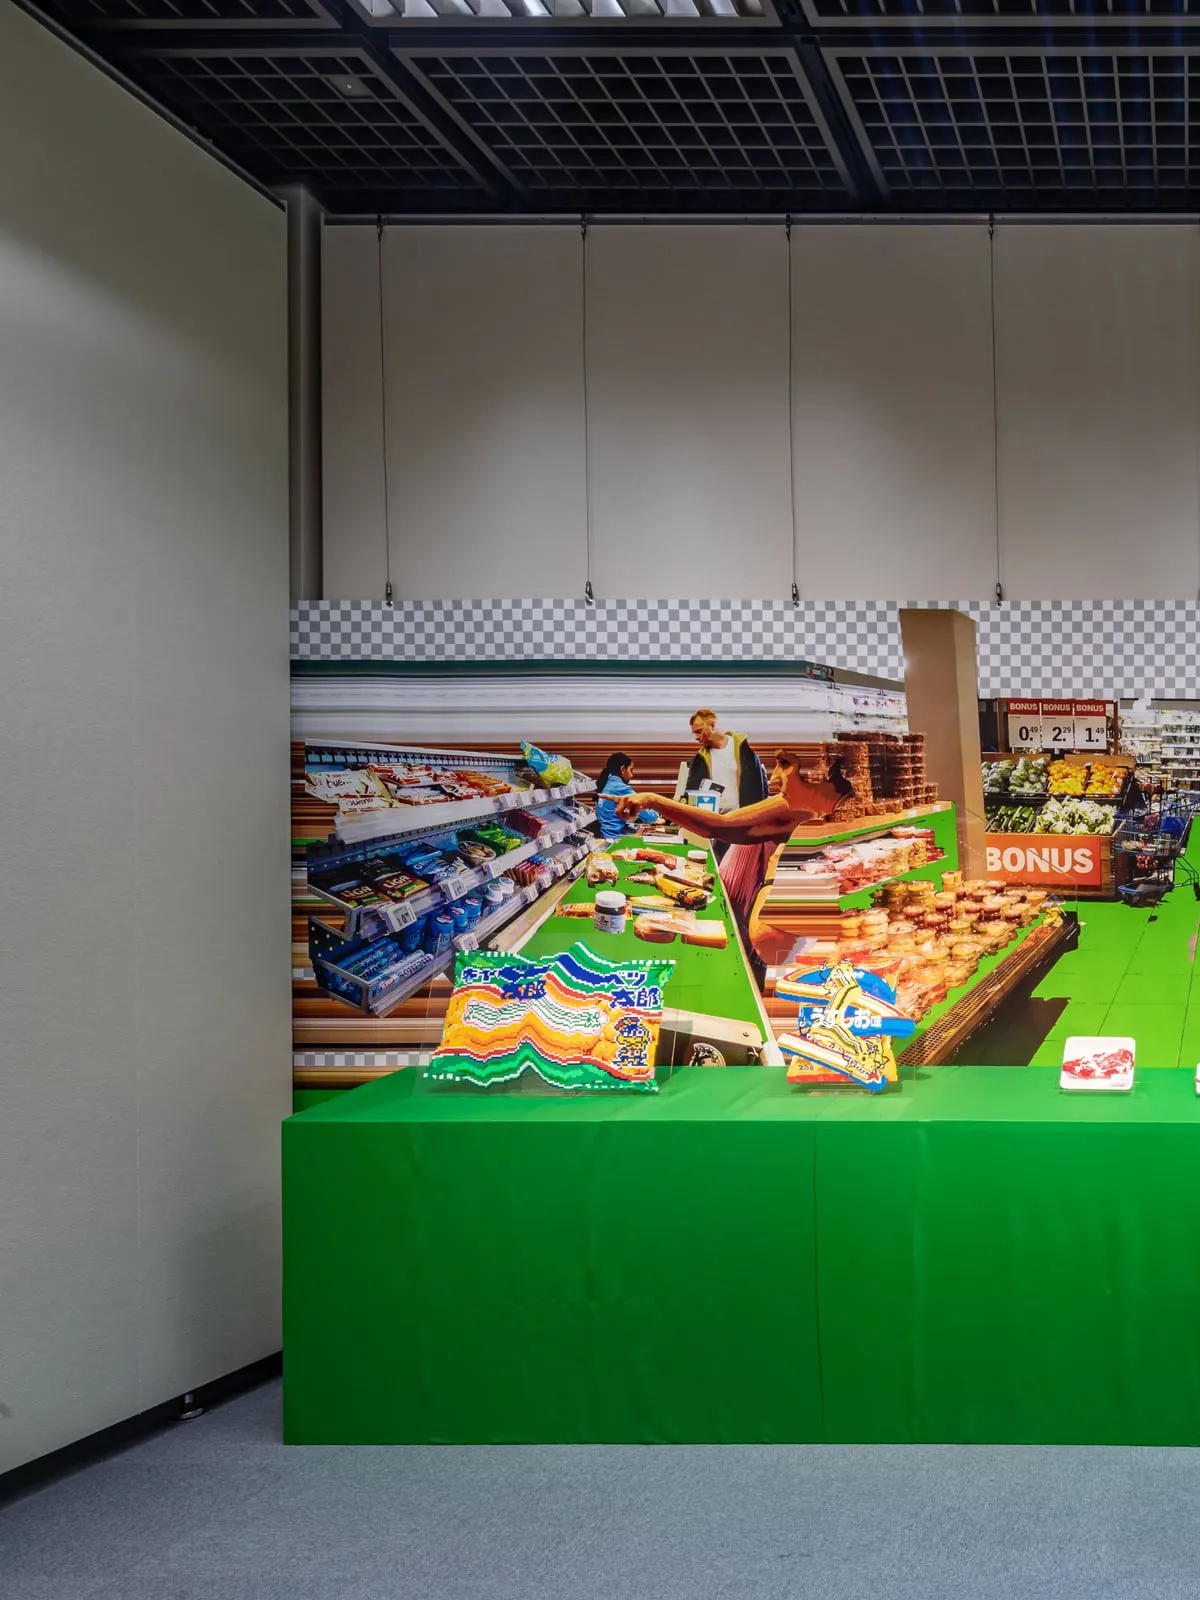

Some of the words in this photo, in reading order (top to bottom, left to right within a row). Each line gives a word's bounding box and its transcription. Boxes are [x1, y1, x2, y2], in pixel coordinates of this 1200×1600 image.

[1009, 703, 1038, 711] BONUS
[1043, 703, 1071, 711] BONUS
[1076, 704, 1104, 712] BONUS
[986, 847, 1094, 874] BONUS
[610, 988, 660, 1008] 太郎
